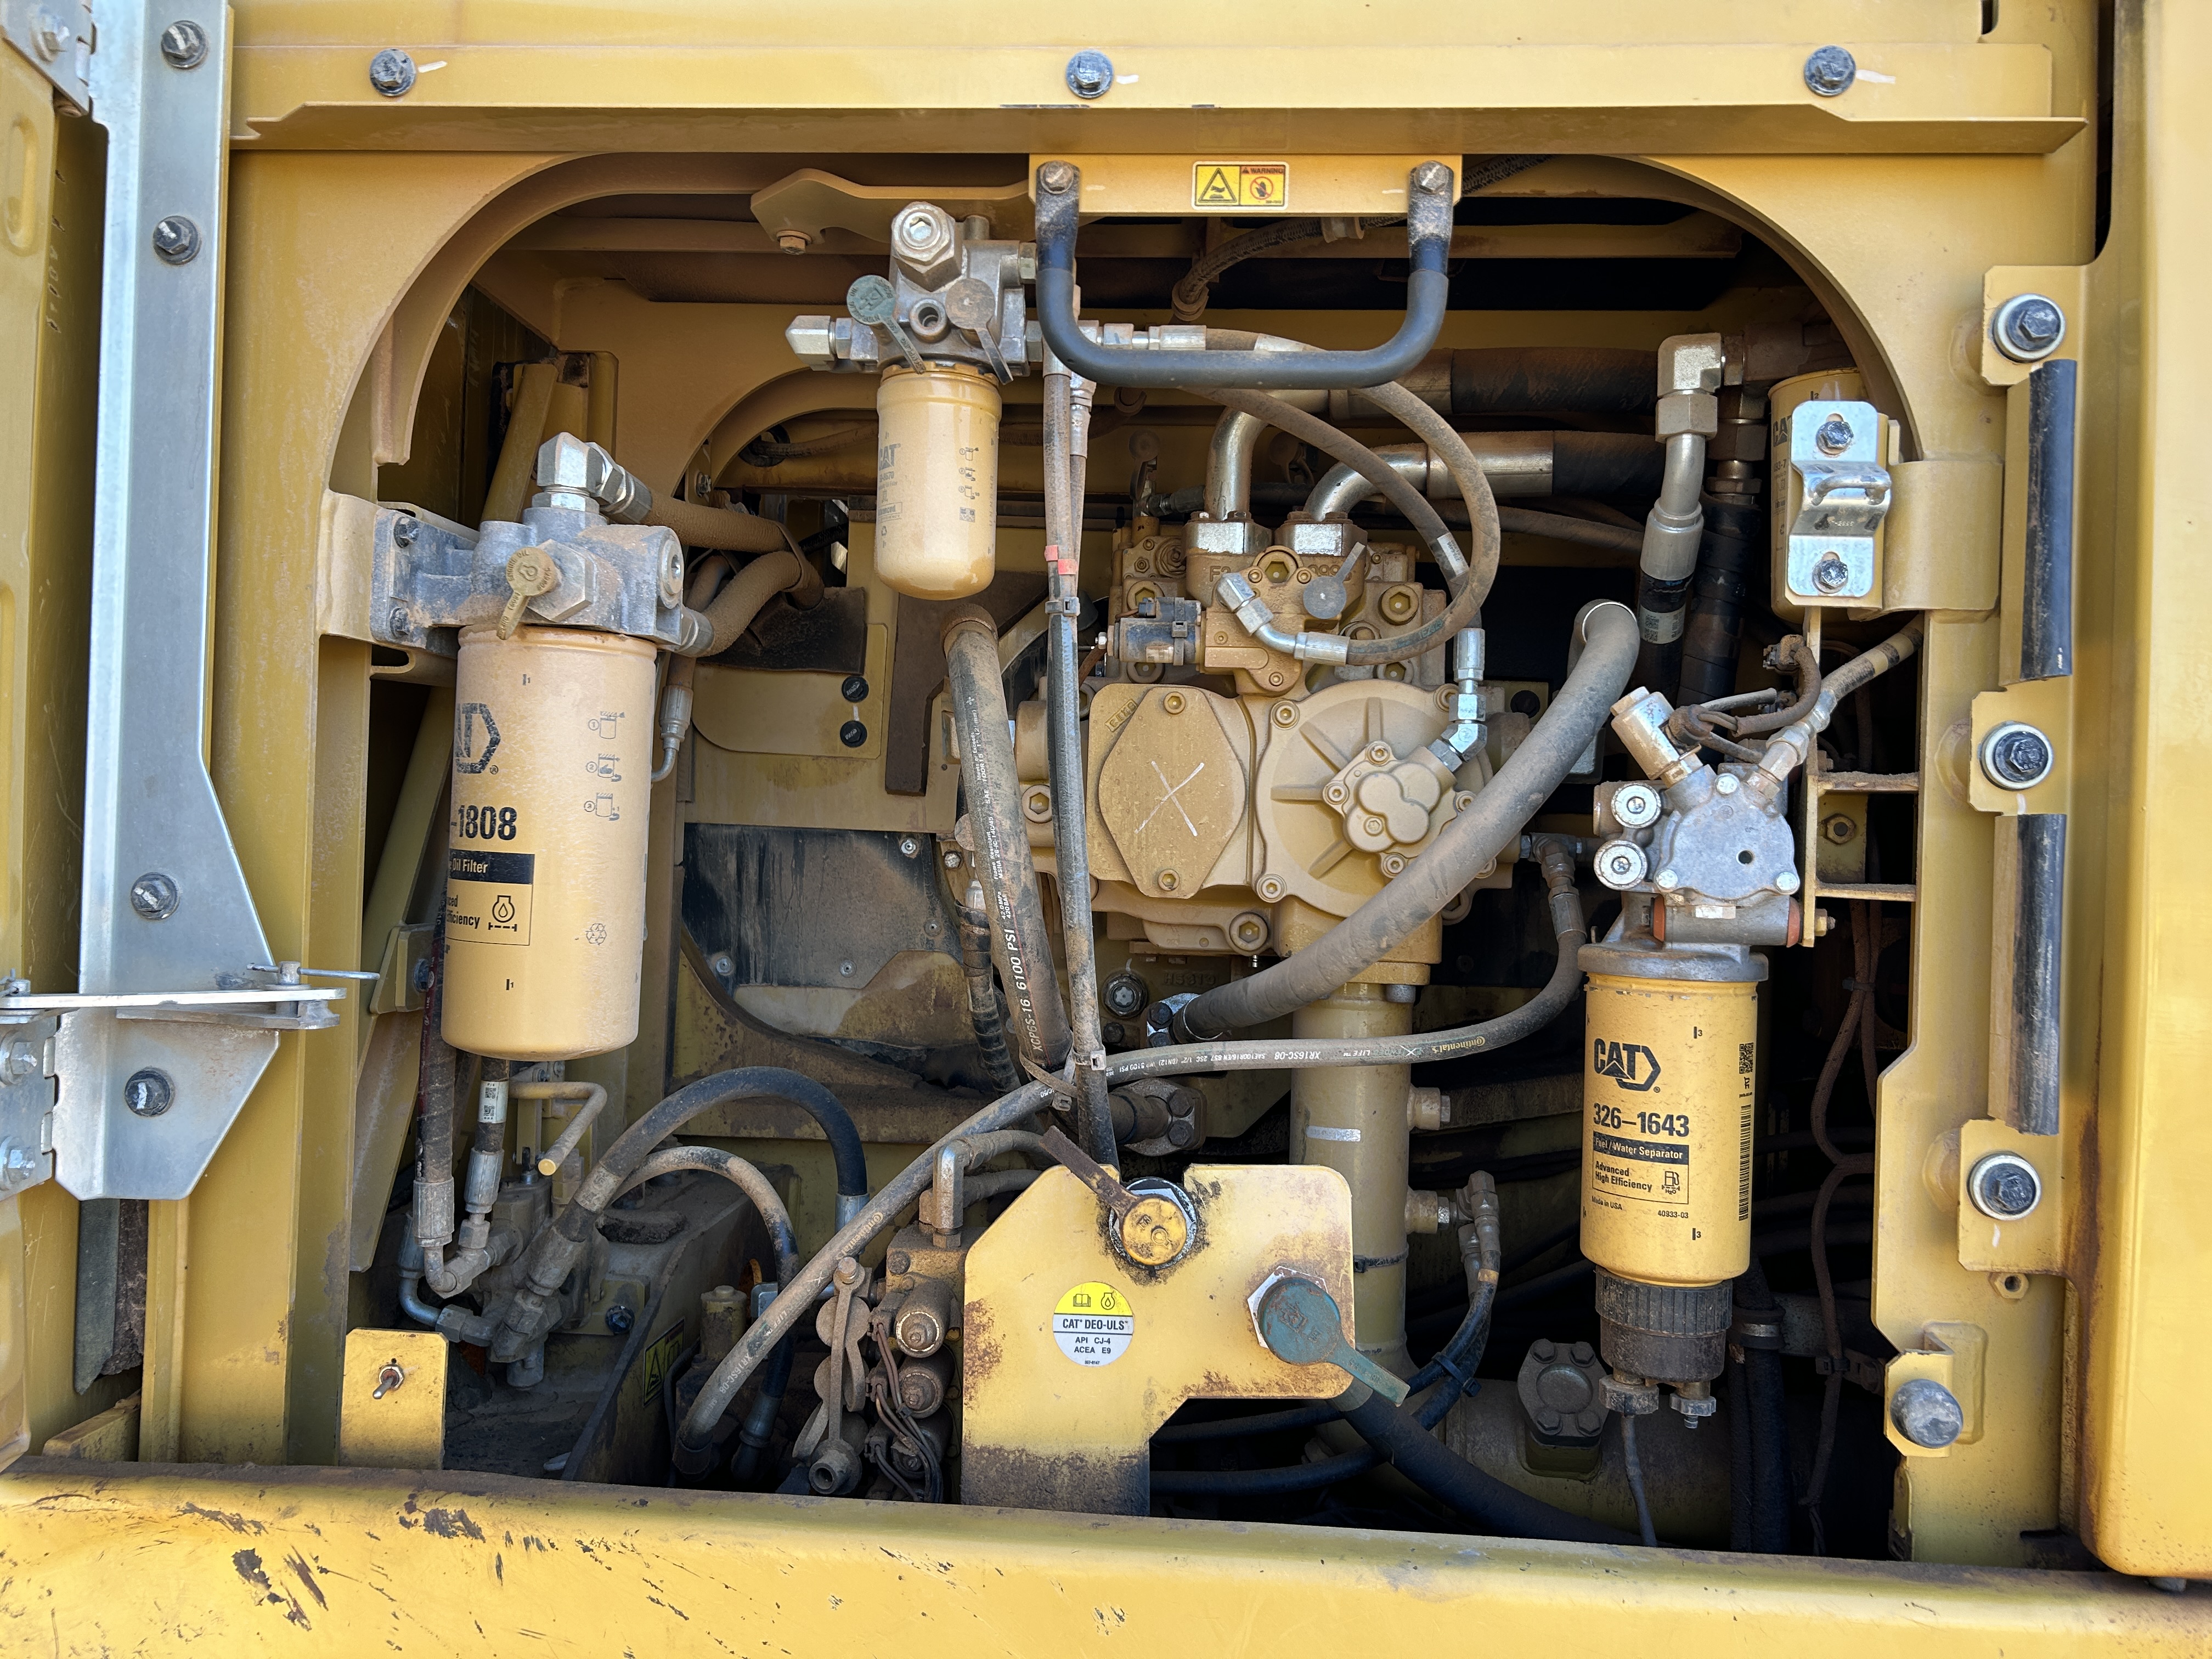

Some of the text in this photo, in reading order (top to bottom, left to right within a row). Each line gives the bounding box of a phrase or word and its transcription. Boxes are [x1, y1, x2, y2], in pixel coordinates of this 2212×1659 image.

[462, 859, 488, 874] Filter
[1006, 928, 1020, 952] PSI
[1013, 957, 1027, 991] 6100
[1274, 1051, 1321, 1060] XR16SC-08
[1594, 1038, 1641, 1081] CAT
[1593, 1103, 1690, 1138] 326-1643
[1639, 1146, 1684, 1159] Separator
[1595, 1160, 1630, 1177] Advanced
[1595, 1171, 1653, 1193] High Efficiency
[1592, 1195, 1604, 1205] Made
[1610, 1201, 1623, 1210] USA
[1657, 1210, 1689, 1219] 40933-03
